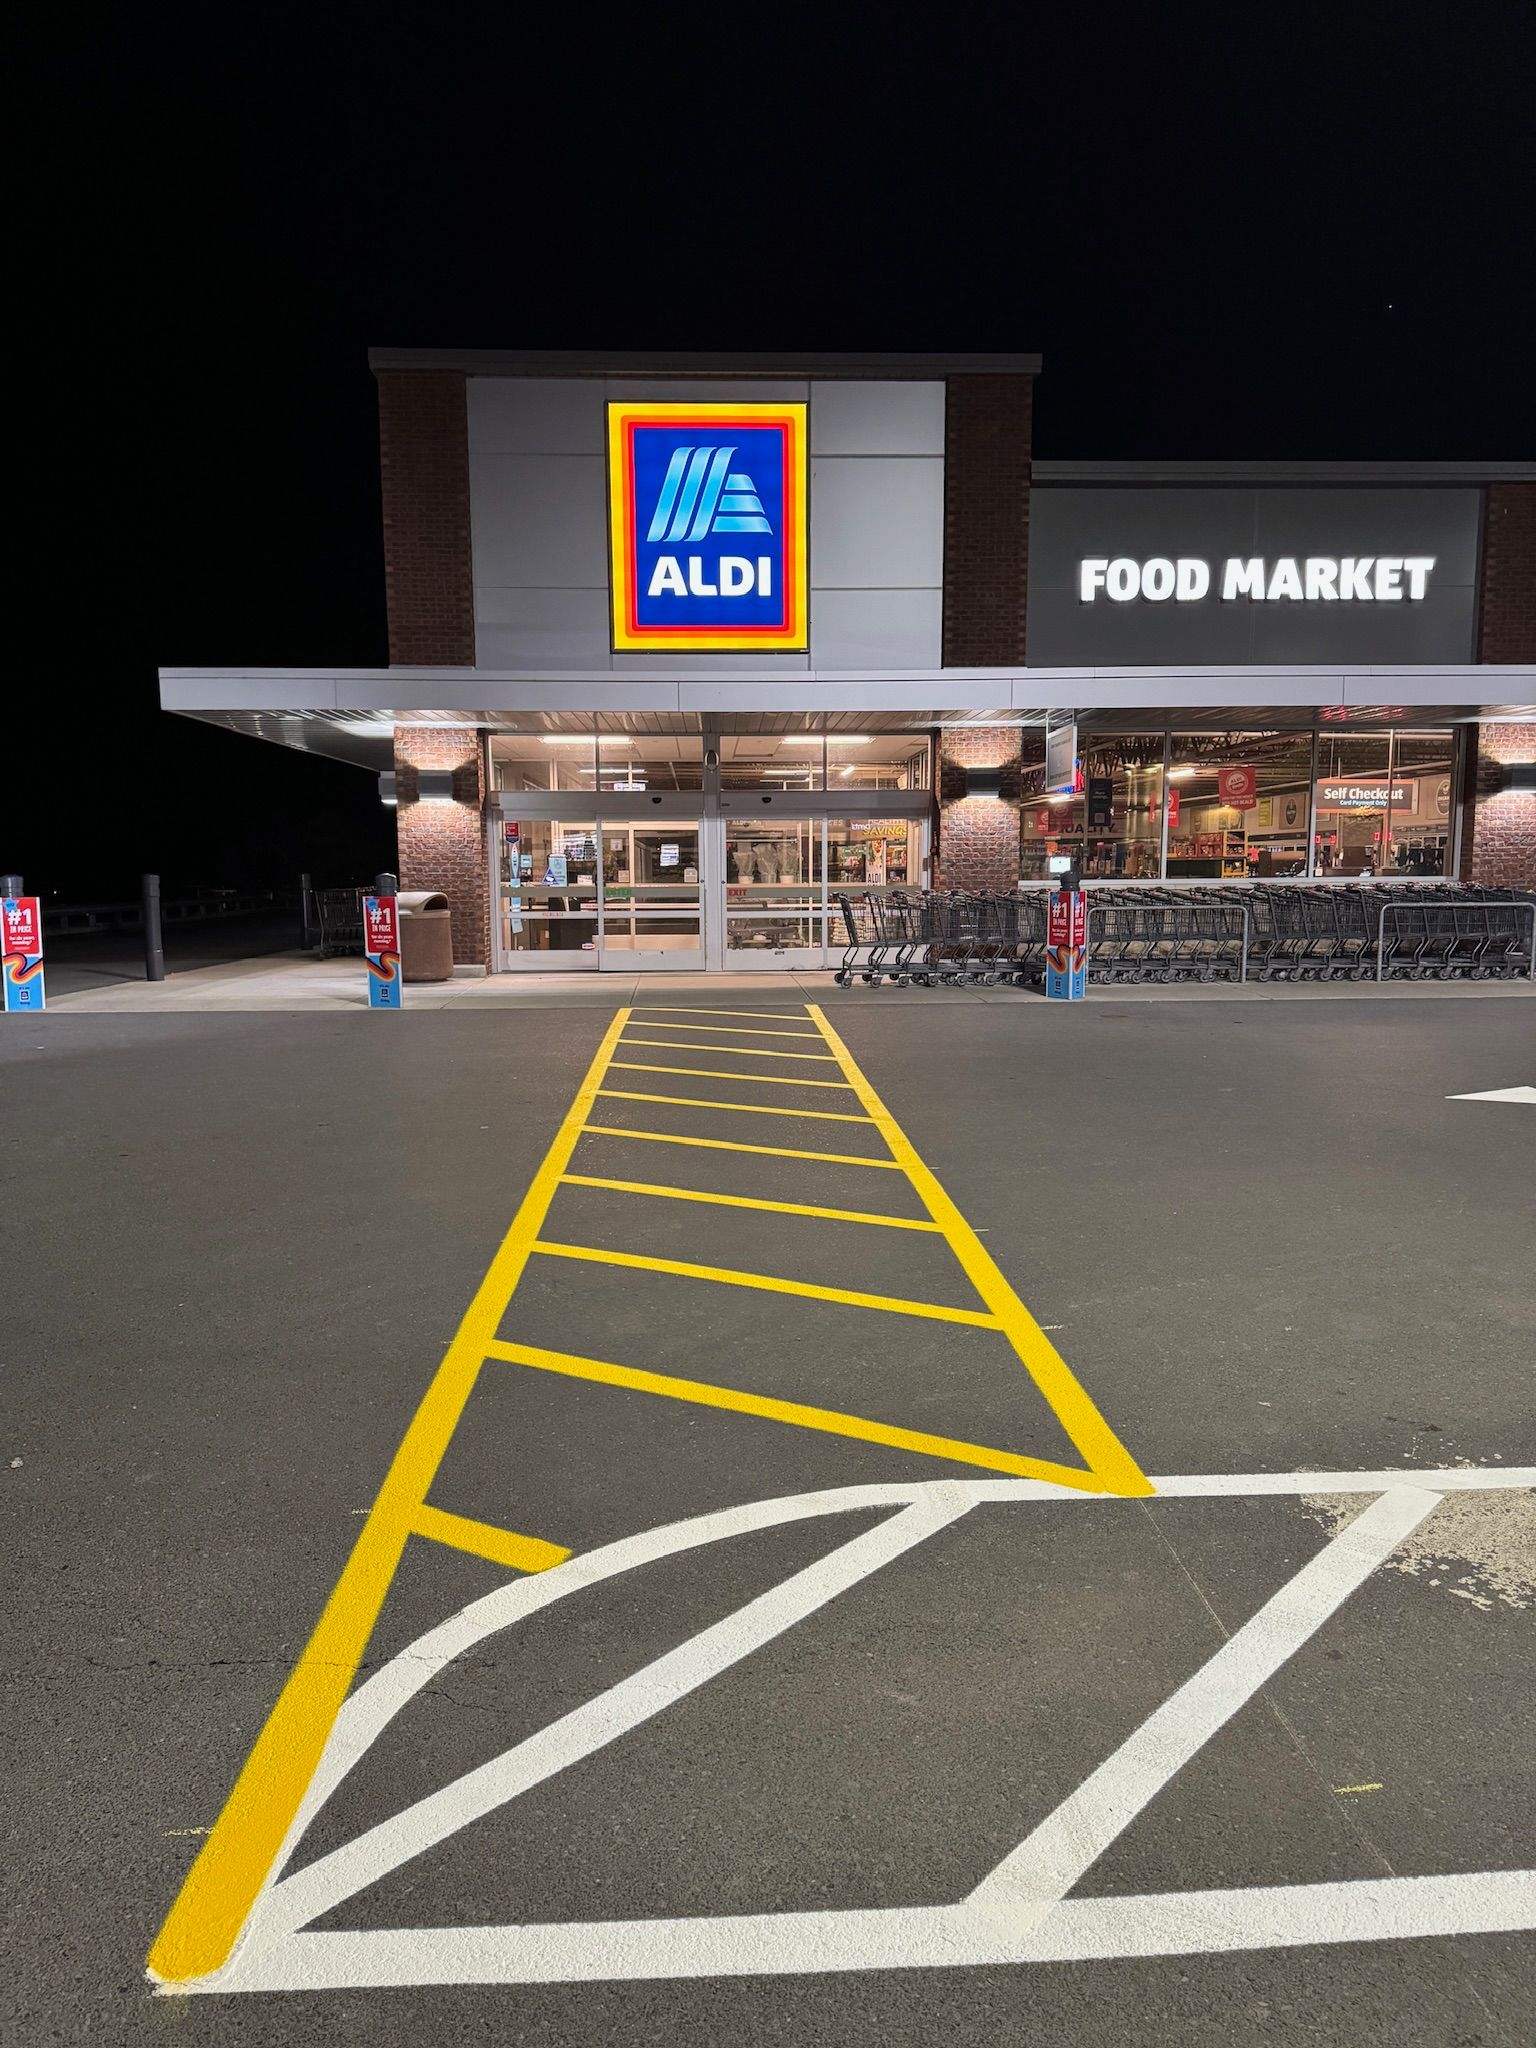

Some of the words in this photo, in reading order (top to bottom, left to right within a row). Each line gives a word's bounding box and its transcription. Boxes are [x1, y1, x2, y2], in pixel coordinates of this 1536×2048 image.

[648, 556, 771, 596] ALDI
[1081, 558, 1210, 601] FOOD
[1223, 558, 1435, 601] MARKET
[1324, 787, 1348, 800] Self
[1349, 787, 1404, 800] Checkout
[863, 825, 907, 835] SAVINGS
[728, 888, 747, 897] EXIT
[8, 908, 32, 925] #1
[370, 908, 391, 924] #1
[1052, 902, 1068, 918] #1
[10, 926, 17, 934] IN
